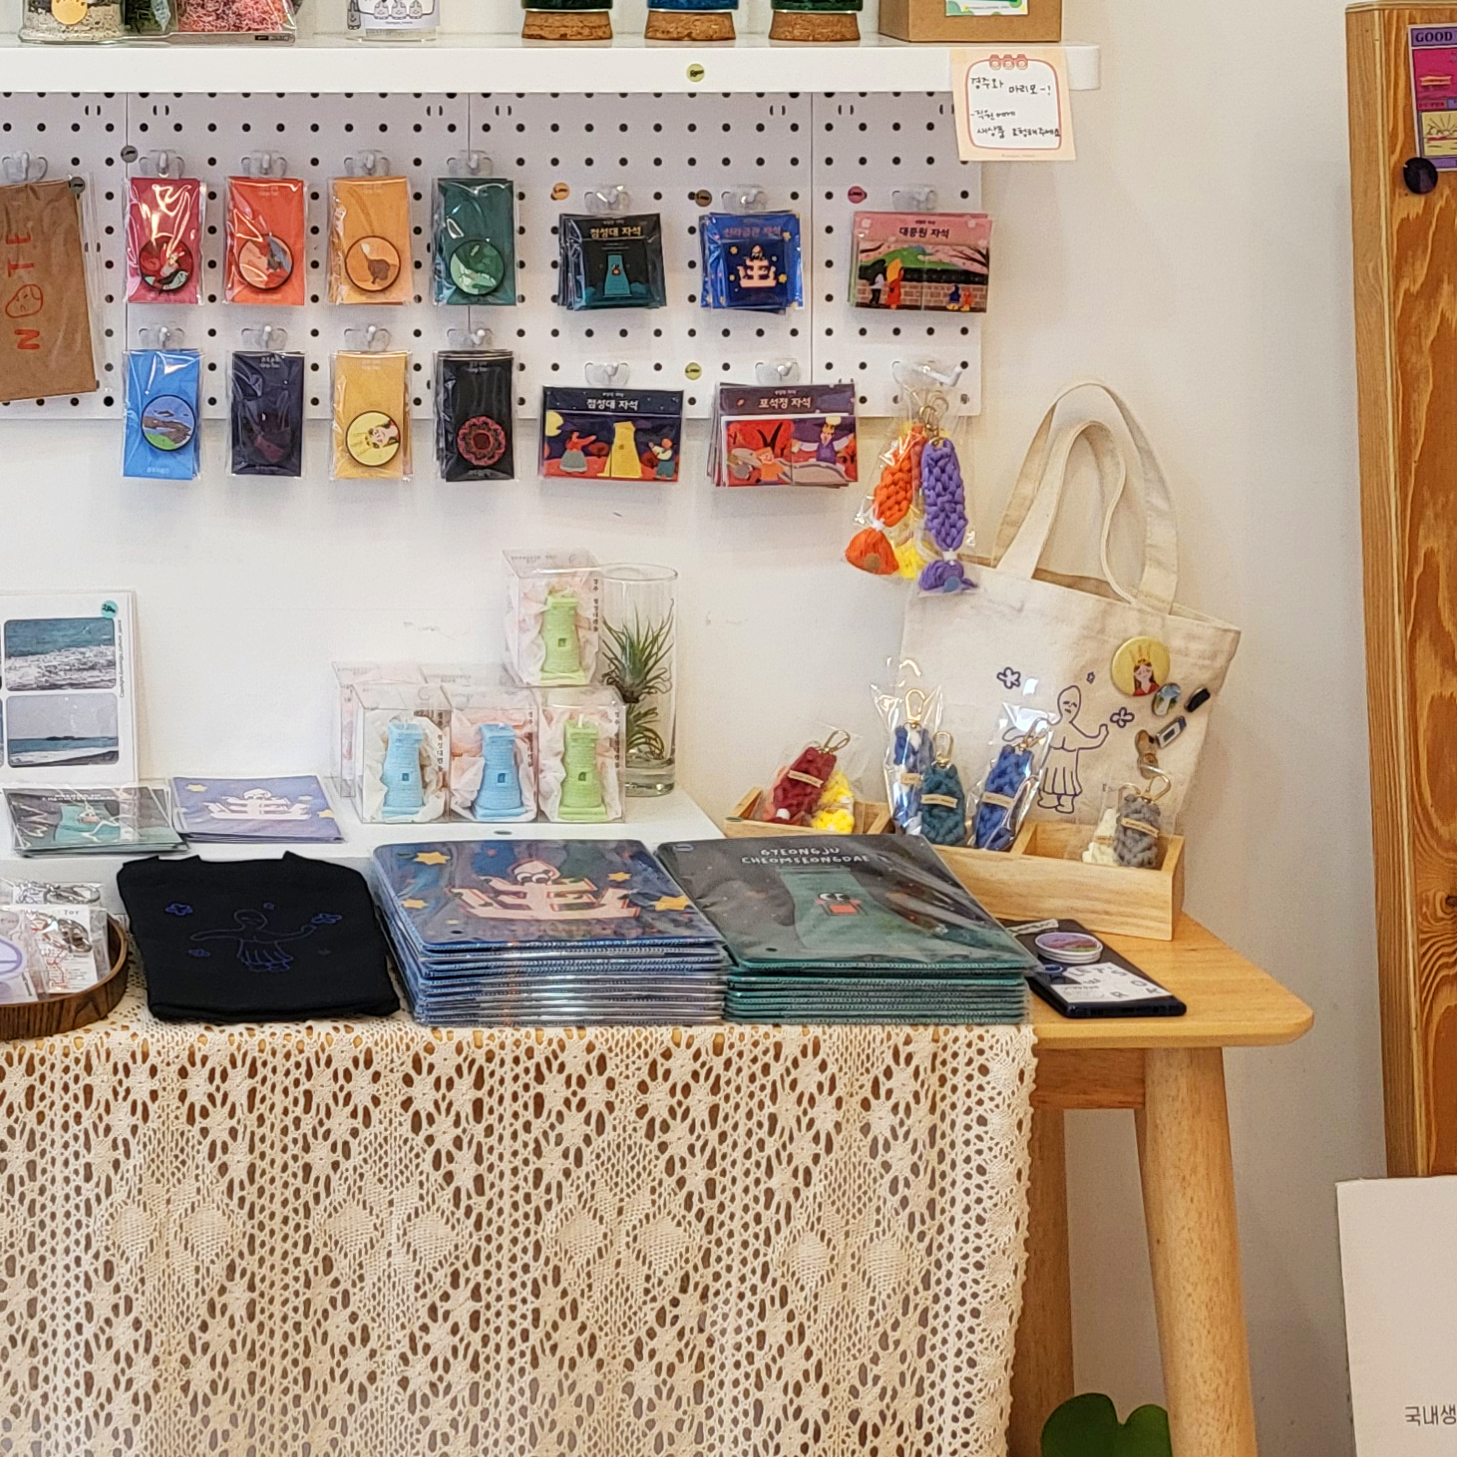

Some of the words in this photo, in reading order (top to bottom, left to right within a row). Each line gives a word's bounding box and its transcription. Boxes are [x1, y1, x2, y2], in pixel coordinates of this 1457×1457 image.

[1415, 31, 1454, 43] GOOD
[970, 75, 1005, 92] 경주와
[976, 125, 1006, 140] 새상품
[1011, 125, 1061, 139] 요청해주세요
[589, 226, 619, 239] 첨성대
[621, 226, 642, 238] 자석
[762, 226, 782, 237] 자석
[898, 226, 928, 238] 대릉원
[931, 228, 950, 239] 자석
[5, 232, 44, 350] NOTE
[585, 399, 616, 410] 첨성대
[618, 399, 639, 411] 자석
[758, 397, 789, 409] 포석정
[791, 397, 812, 409] 자석
[759, 846, 841, 858] GYEONGJU
[741, 853, 871, 865] CHEOMSEONGDAE
[63, 908, 80, 916] TOY
[1405, 1404, 1457, 1427] 국내생
